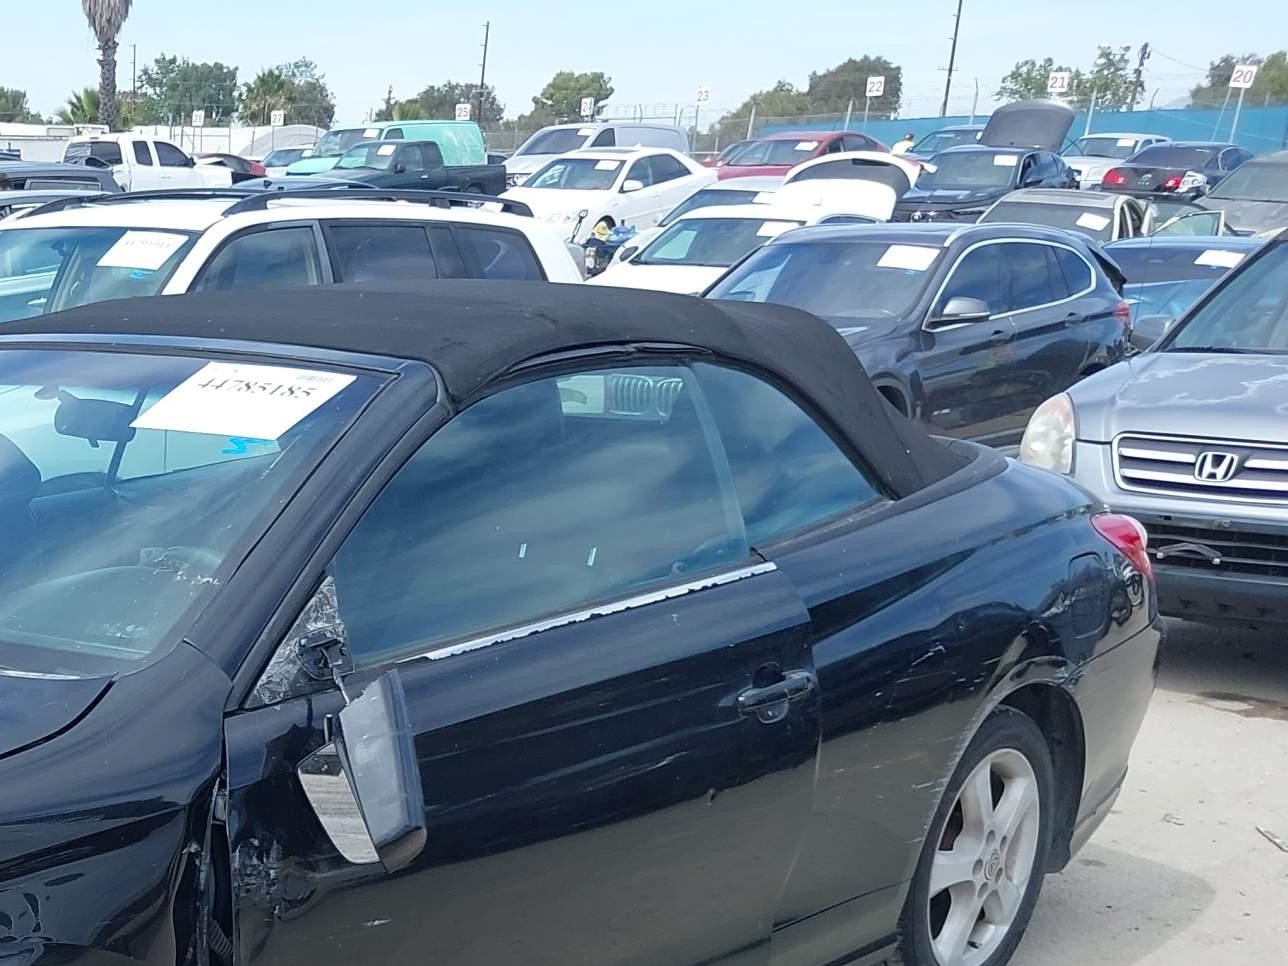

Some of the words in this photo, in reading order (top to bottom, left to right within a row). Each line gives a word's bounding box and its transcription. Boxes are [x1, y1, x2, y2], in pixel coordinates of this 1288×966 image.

[1049, 76, 1065, 88] 21
[1232, 70, 1253, 83] 20
[868, 81, 882, 92] 22
[696, 90, 709, 101] 23
[456, 107, 469, 117] 25
[272, 114, 282, 123] 27
[198, 377, 317, 398] 44785185
